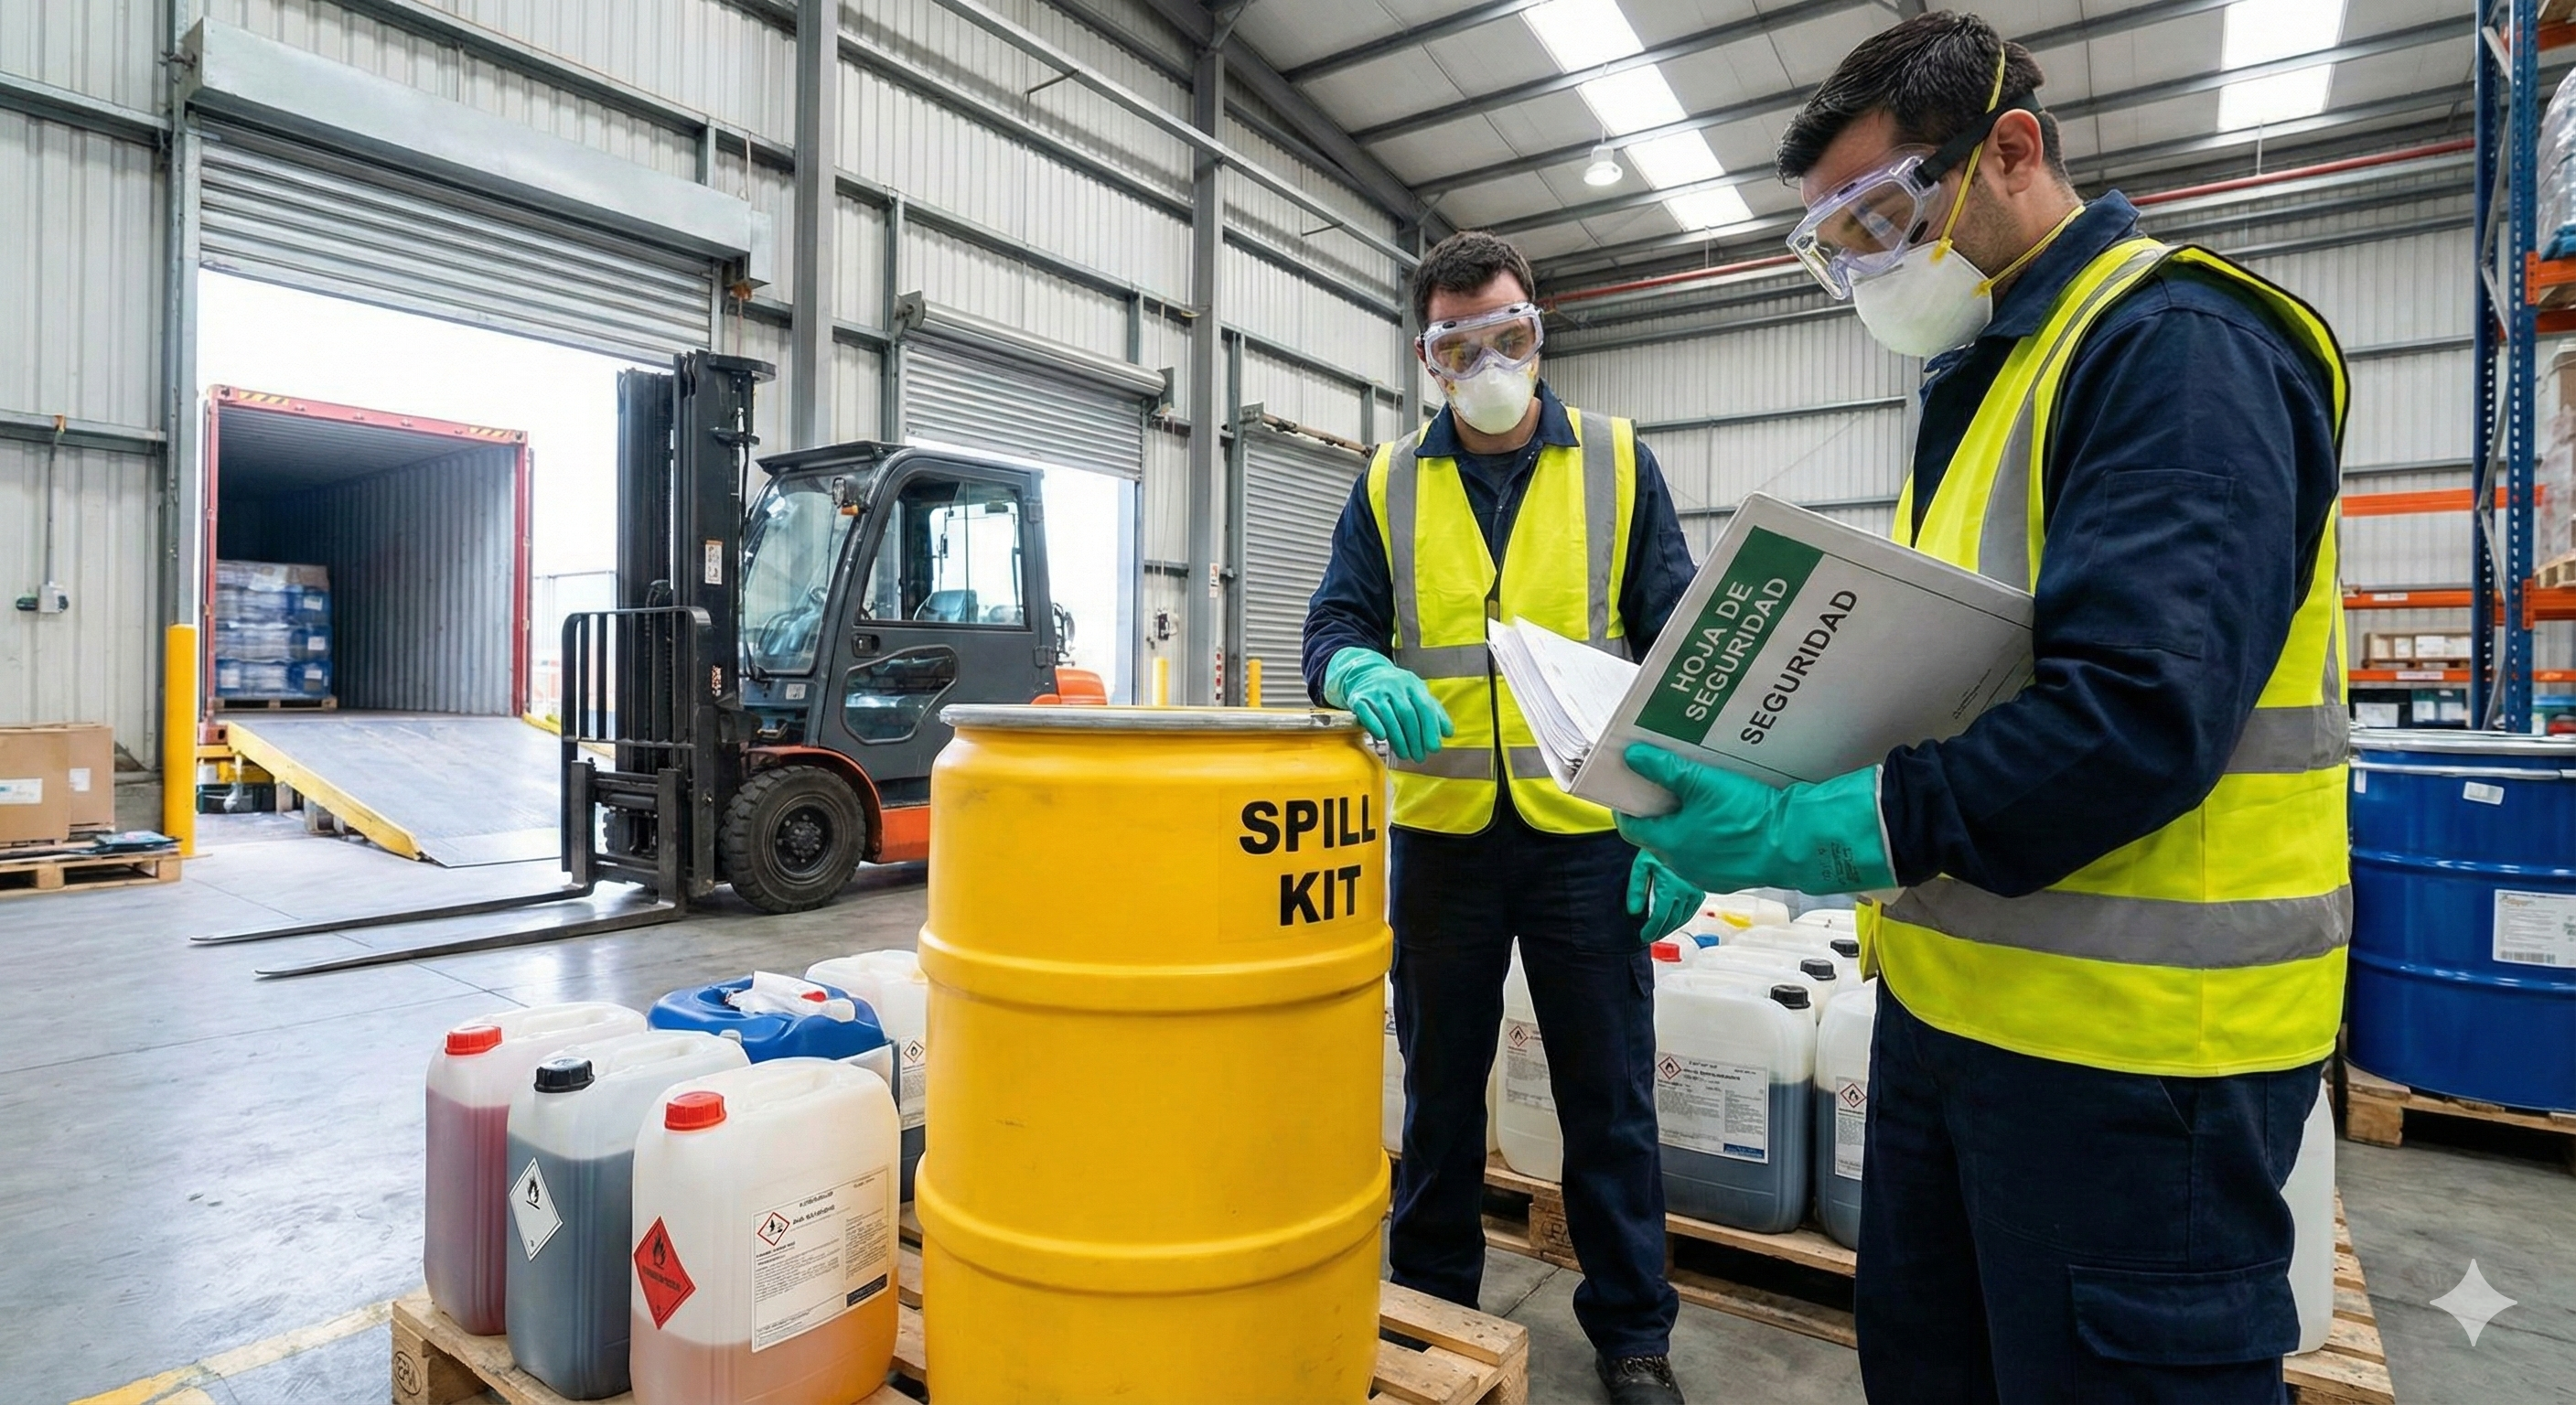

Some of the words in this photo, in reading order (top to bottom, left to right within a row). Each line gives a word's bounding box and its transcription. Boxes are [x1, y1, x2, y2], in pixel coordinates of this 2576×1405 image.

[1669, 626, 1727, 692] HOJA
[1715, 581, 1754, 620] DE
[1685, 577, 1788, 722] SEGURIDAD
[1740, 590, 1858, 745] SEGURIDAD
[1240, 794, 1376, 855] SPILL
[1280, 864, 1361, 927] KIT
